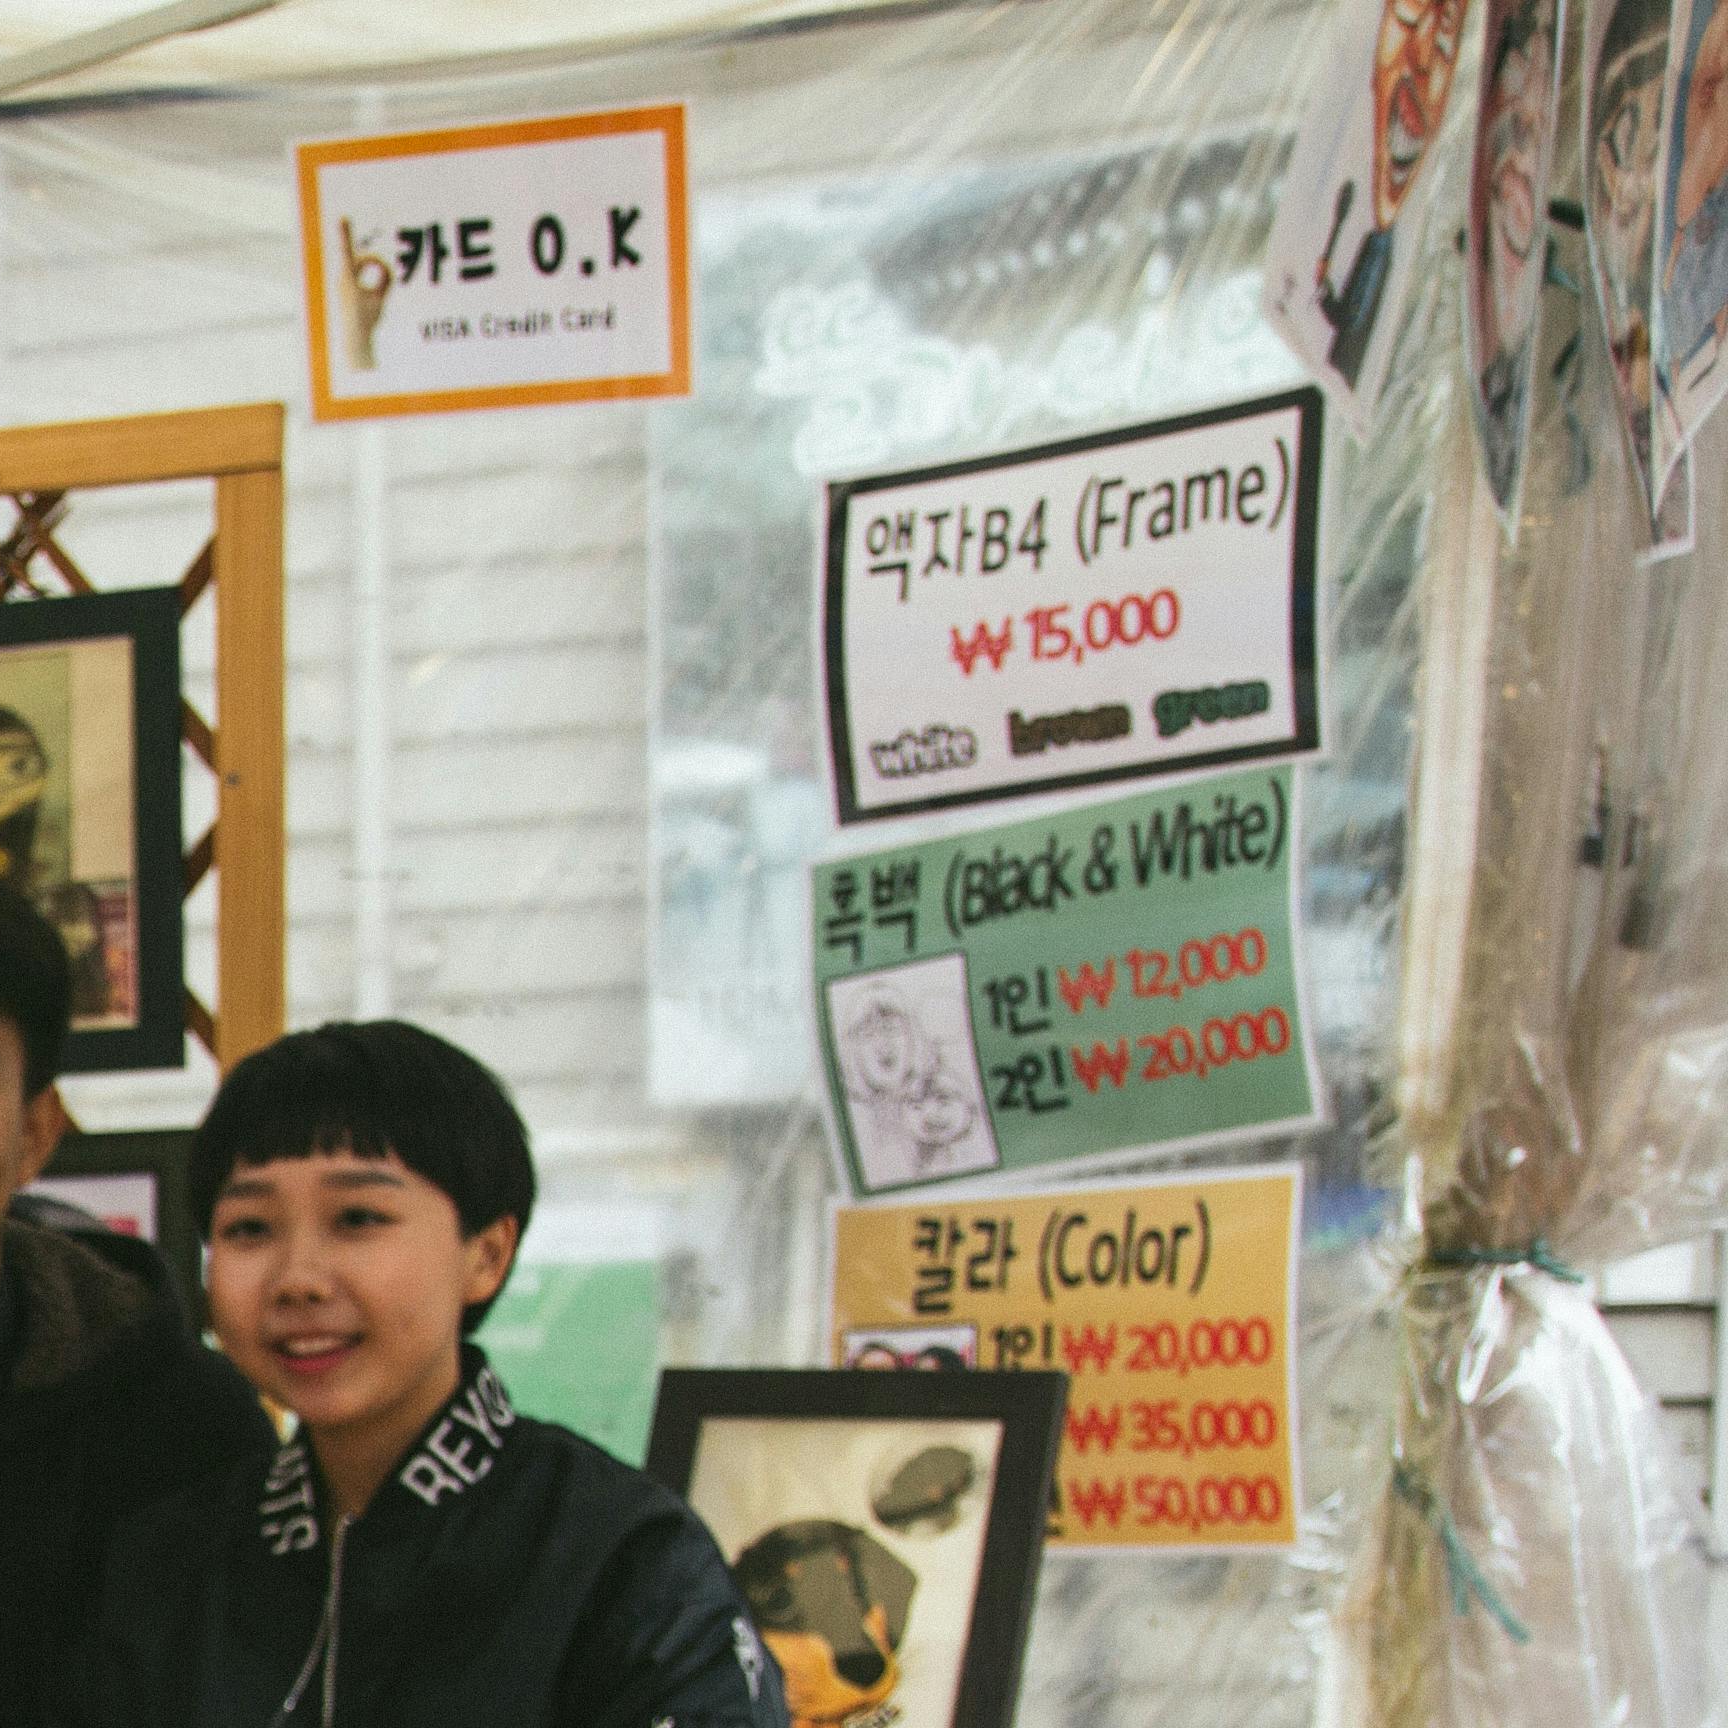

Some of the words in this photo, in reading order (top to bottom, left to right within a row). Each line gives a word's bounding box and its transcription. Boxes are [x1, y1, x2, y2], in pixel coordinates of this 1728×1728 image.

[396, 216, 496, 285] 카드
[530, 204, 641, 277] O.K
[865, 497, 1049, 605] 액자B4
[1074, 436, 1290, 565] (Frame)
[869, 722, 978, 778] white
[824, 857, 921, 964] 흑백
[1082, 823, 1117, 896] &
[982, 966, 1052, 1037] 1인
[990, 1047, 1071, 1114] 2인
[1037, 1199, 1212, 1302] (Color)
